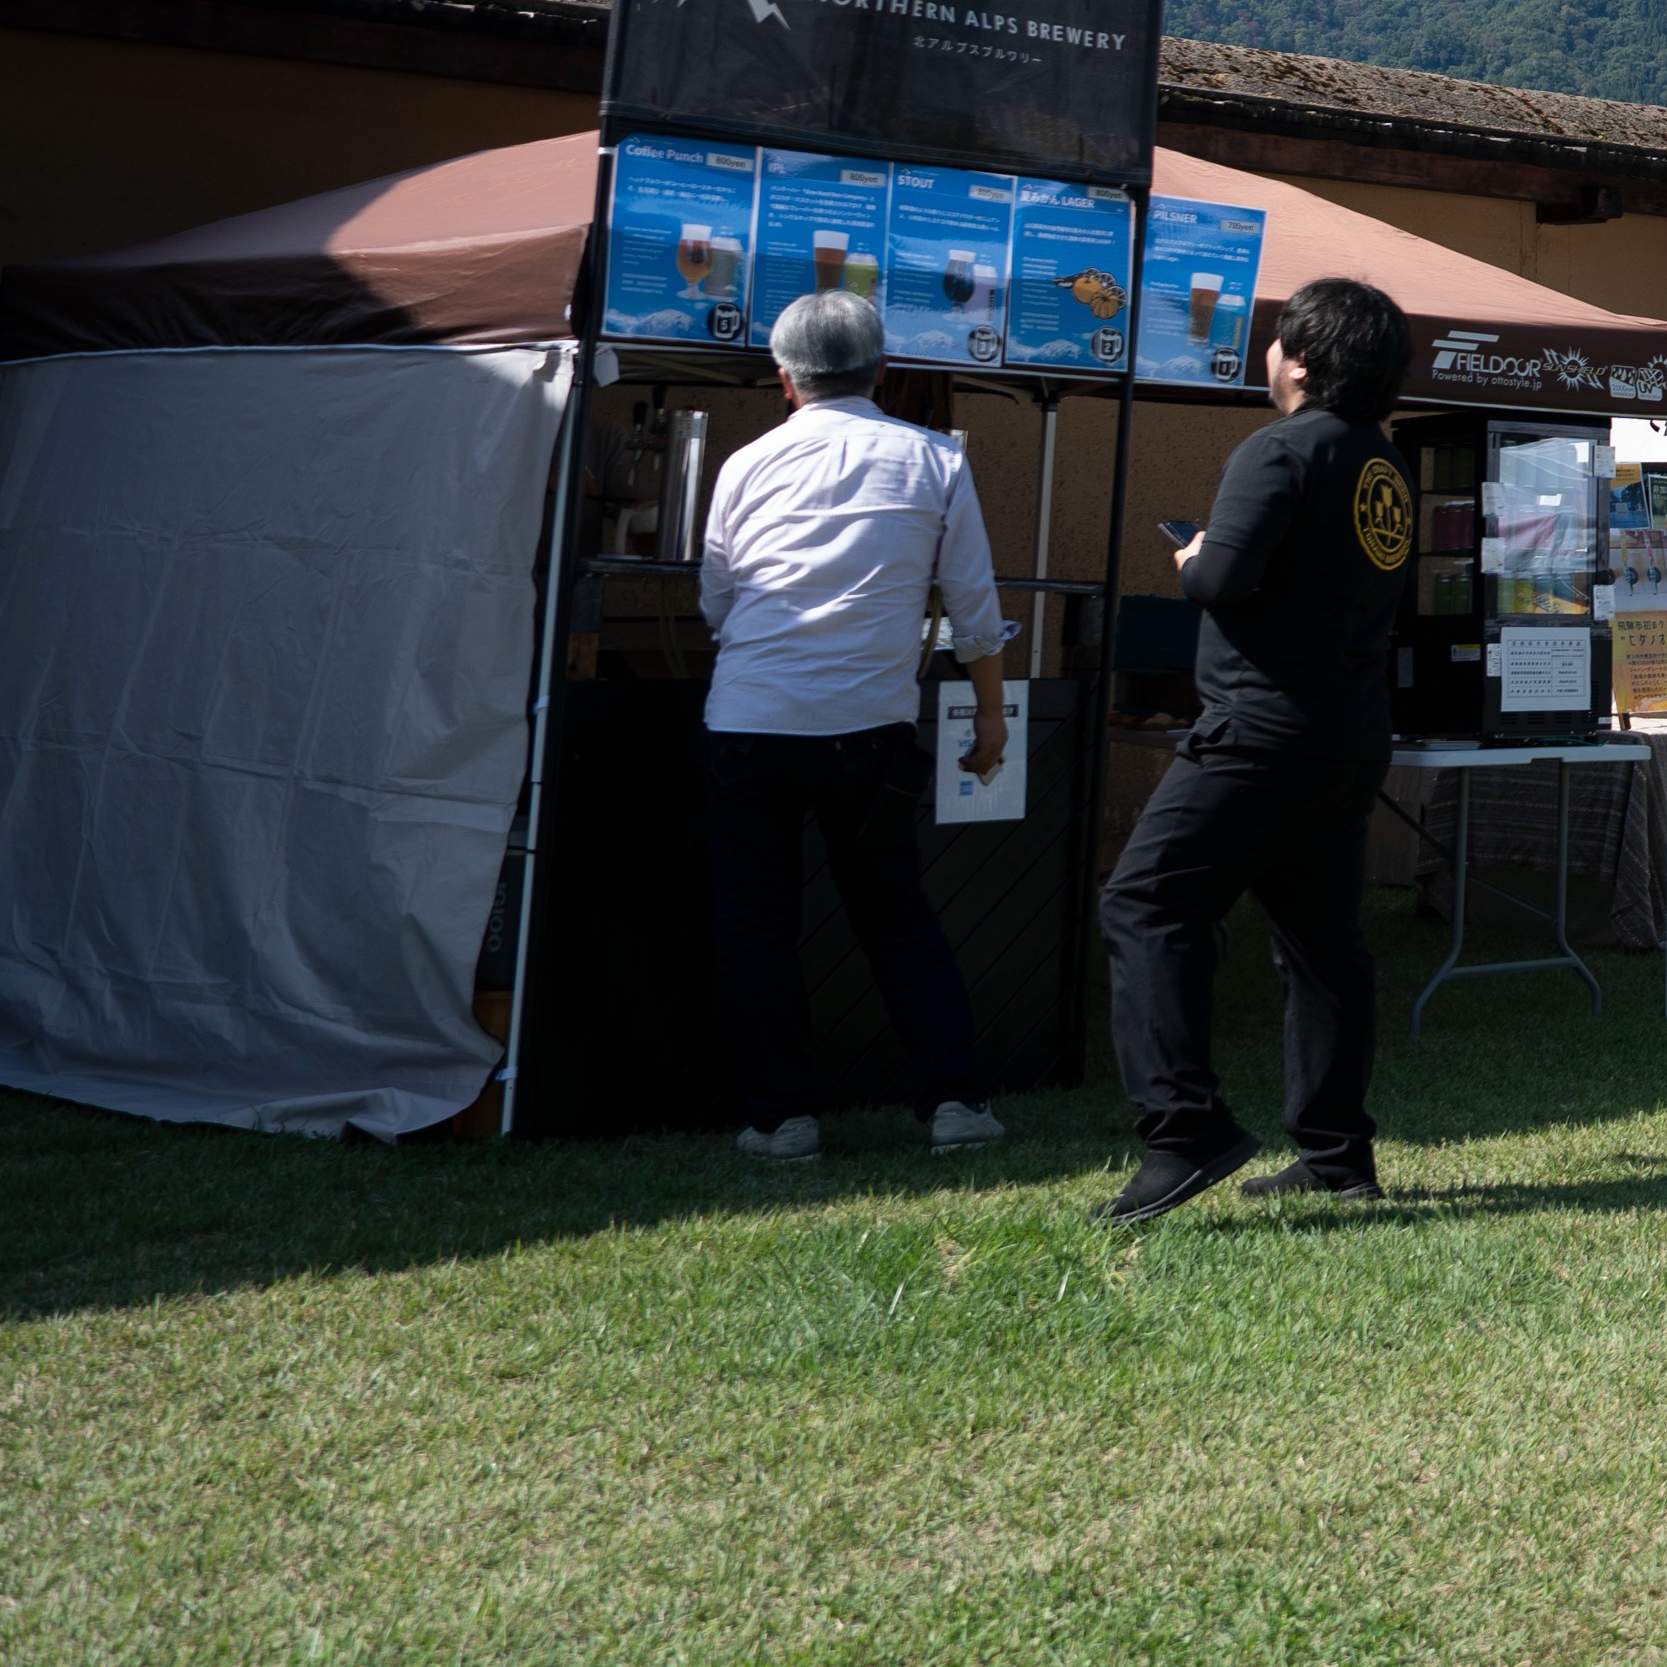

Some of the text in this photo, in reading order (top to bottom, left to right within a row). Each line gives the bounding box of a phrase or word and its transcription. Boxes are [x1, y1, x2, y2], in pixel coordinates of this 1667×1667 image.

[964, 10, 1019, 34] ALPS
[1027, 20, 1127, 50] BREWERY
[913, 35, 1042, 64] 北アルプスブルワリー
[625, 144, 704, 163] Coffee Punch
[715, 156, 746, 168] 800yen
[850, 172, 879, 184] 800yen
[897, 175, 935, 189] STOUT
[1061, 196, 1095, 209] LAGER
[1153, 210, 1198, 224] PILSNER
[720, 319, 728, 330] 5
[1456, 352, 1541, 378] FIELDOOR
[1432, 368, 1543, 390] Powered by ottostyle.jp
[1640, 381, 1654, 394] UV
